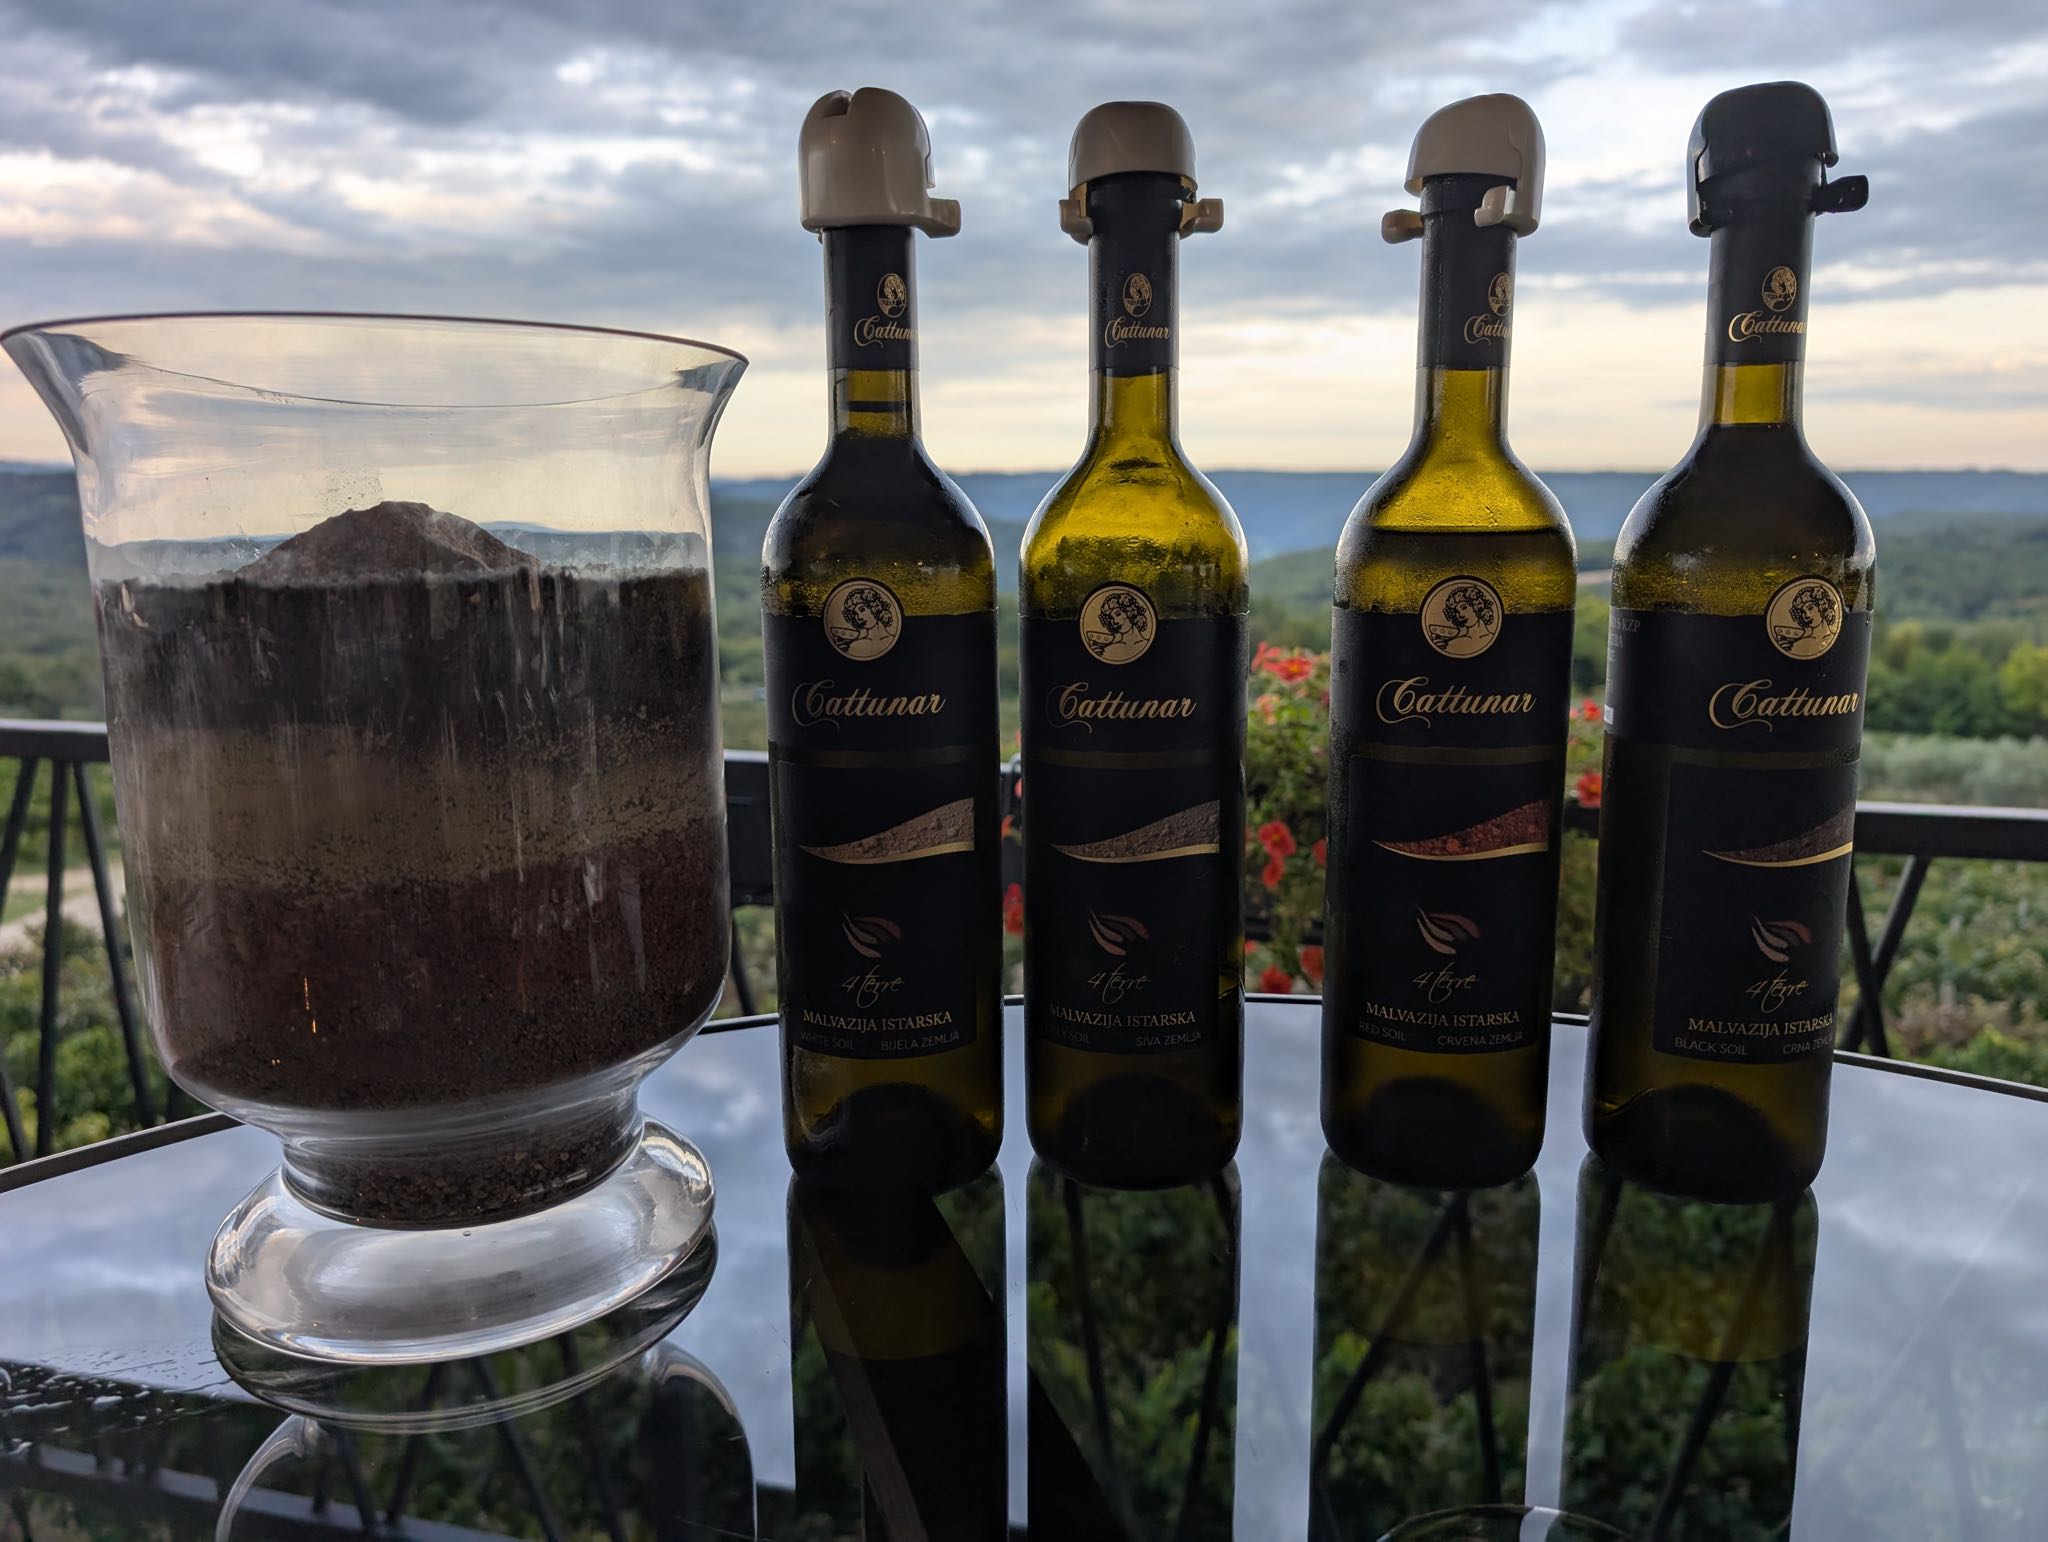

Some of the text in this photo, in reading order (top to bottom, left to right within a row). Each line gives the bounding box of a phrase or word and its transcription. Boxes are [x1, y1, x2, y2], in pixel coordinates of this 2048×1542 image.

[1104, 315, 1171, 350] Cattunar
[792, 679, 946, 732] Cattunar
[1046, 682, 1198, 734] Cattunar
[1375, 676, 1536, 729] Cattunar
[1709, 679, 1860, 733] Cattunar
[802, 1008, 953, 1034] MALVAZIJA ISTARSKA
[1048, 1002, 1196, 1030] MALVAZIJA ISTARSKA
[1364, 1001, 1520, 1029] MALVAZIJA ISTARSKA
[1687, 1012, 1833, 1040] MALVAZIJA ISTARSKA
[832, 1037, 856, 1051] SOIL
[880, 1039, 919, 1052] BIJELA
[920, 1031, 960, 1049] ZEMLJA
[1135, 1036, 1161, 1048] SIVA
[1163, 1031, 1202, 1047] ZEMLJA
[1359, 1021, 1381, 1035] RED
[1382, 1026, 1407, 1042] SOIL
[1437, 1034, 1488, 1047] CRVENA
[1674, 1036, 1718, 1054] BLACK
[1719, 1043, 1748, 1056] SOIL
[1782, 1041, 1811, 1056] CRNA
